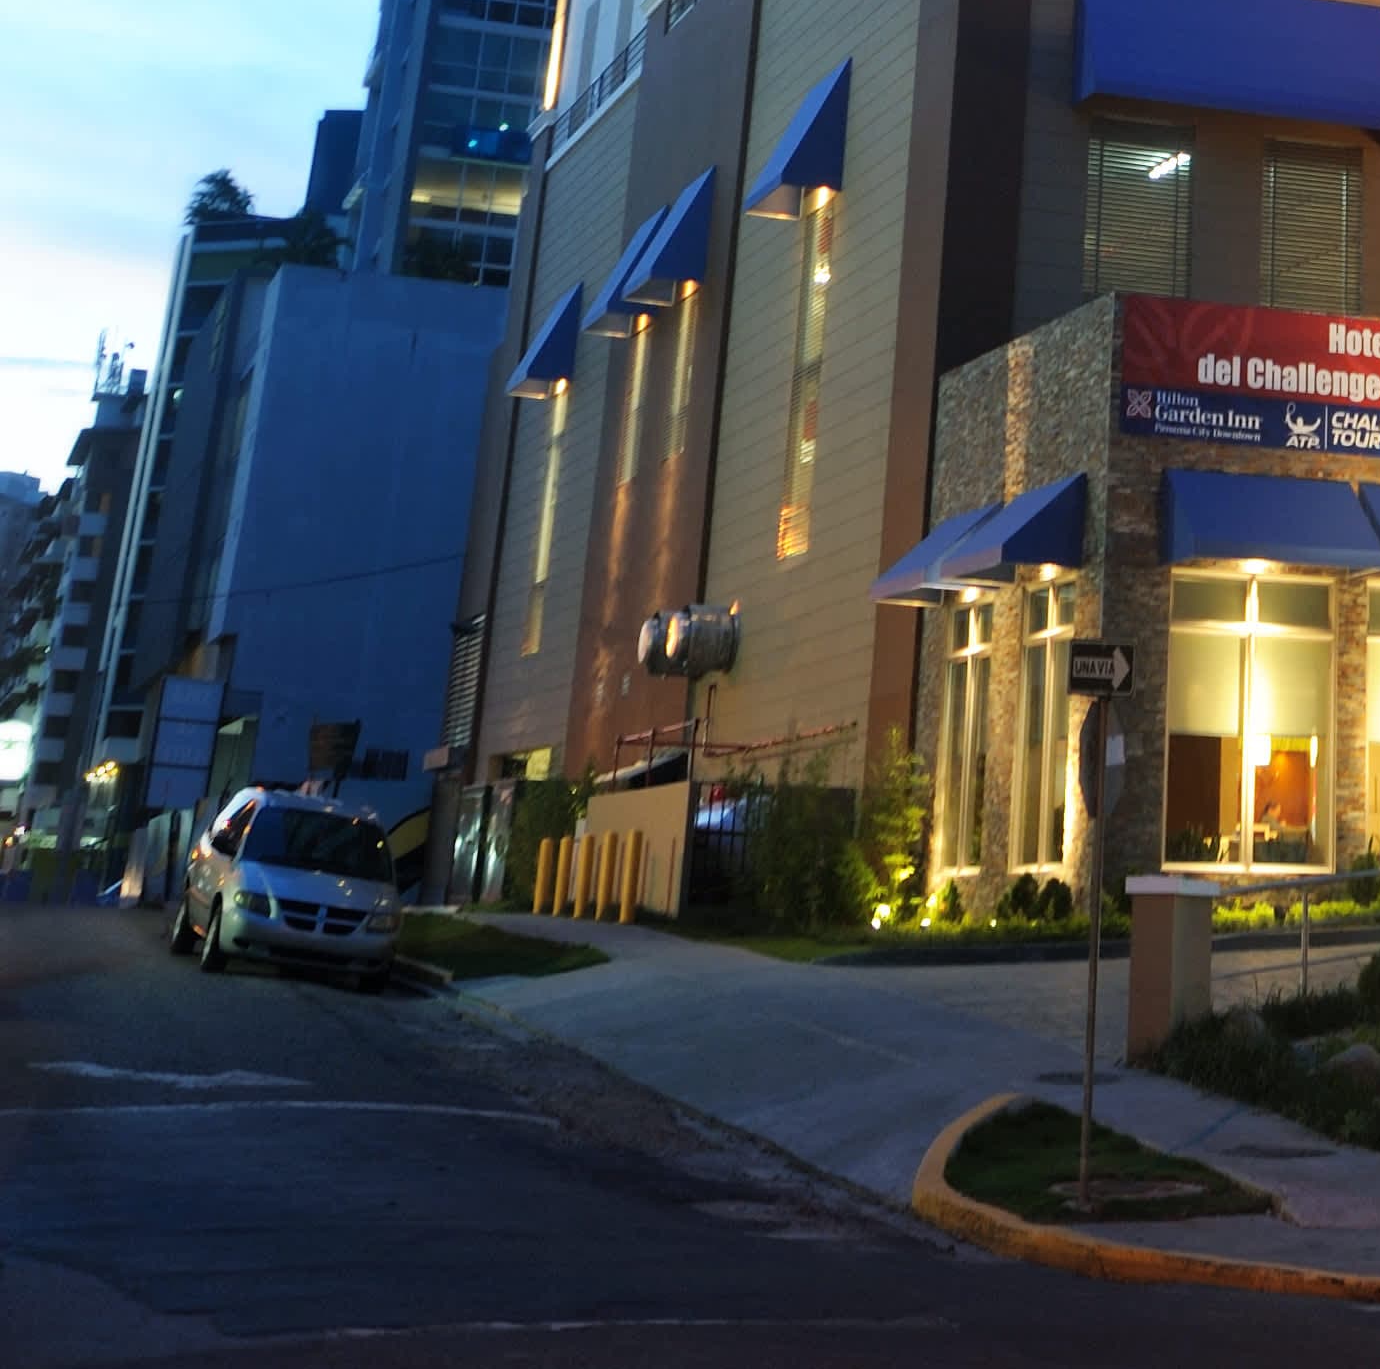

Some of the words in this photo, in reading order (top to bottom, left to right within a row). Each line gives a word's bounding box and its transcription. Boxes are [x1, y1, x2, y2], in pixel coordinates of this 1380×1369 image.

[1198, 353, 1241, 386] del
[1156, 390, 1199, 407] Hilton
[1155, 404, 1224, 426] Garden
[1227, 410, 1260, 430] Inn
[1285, 435, 1318, 449] ATP
